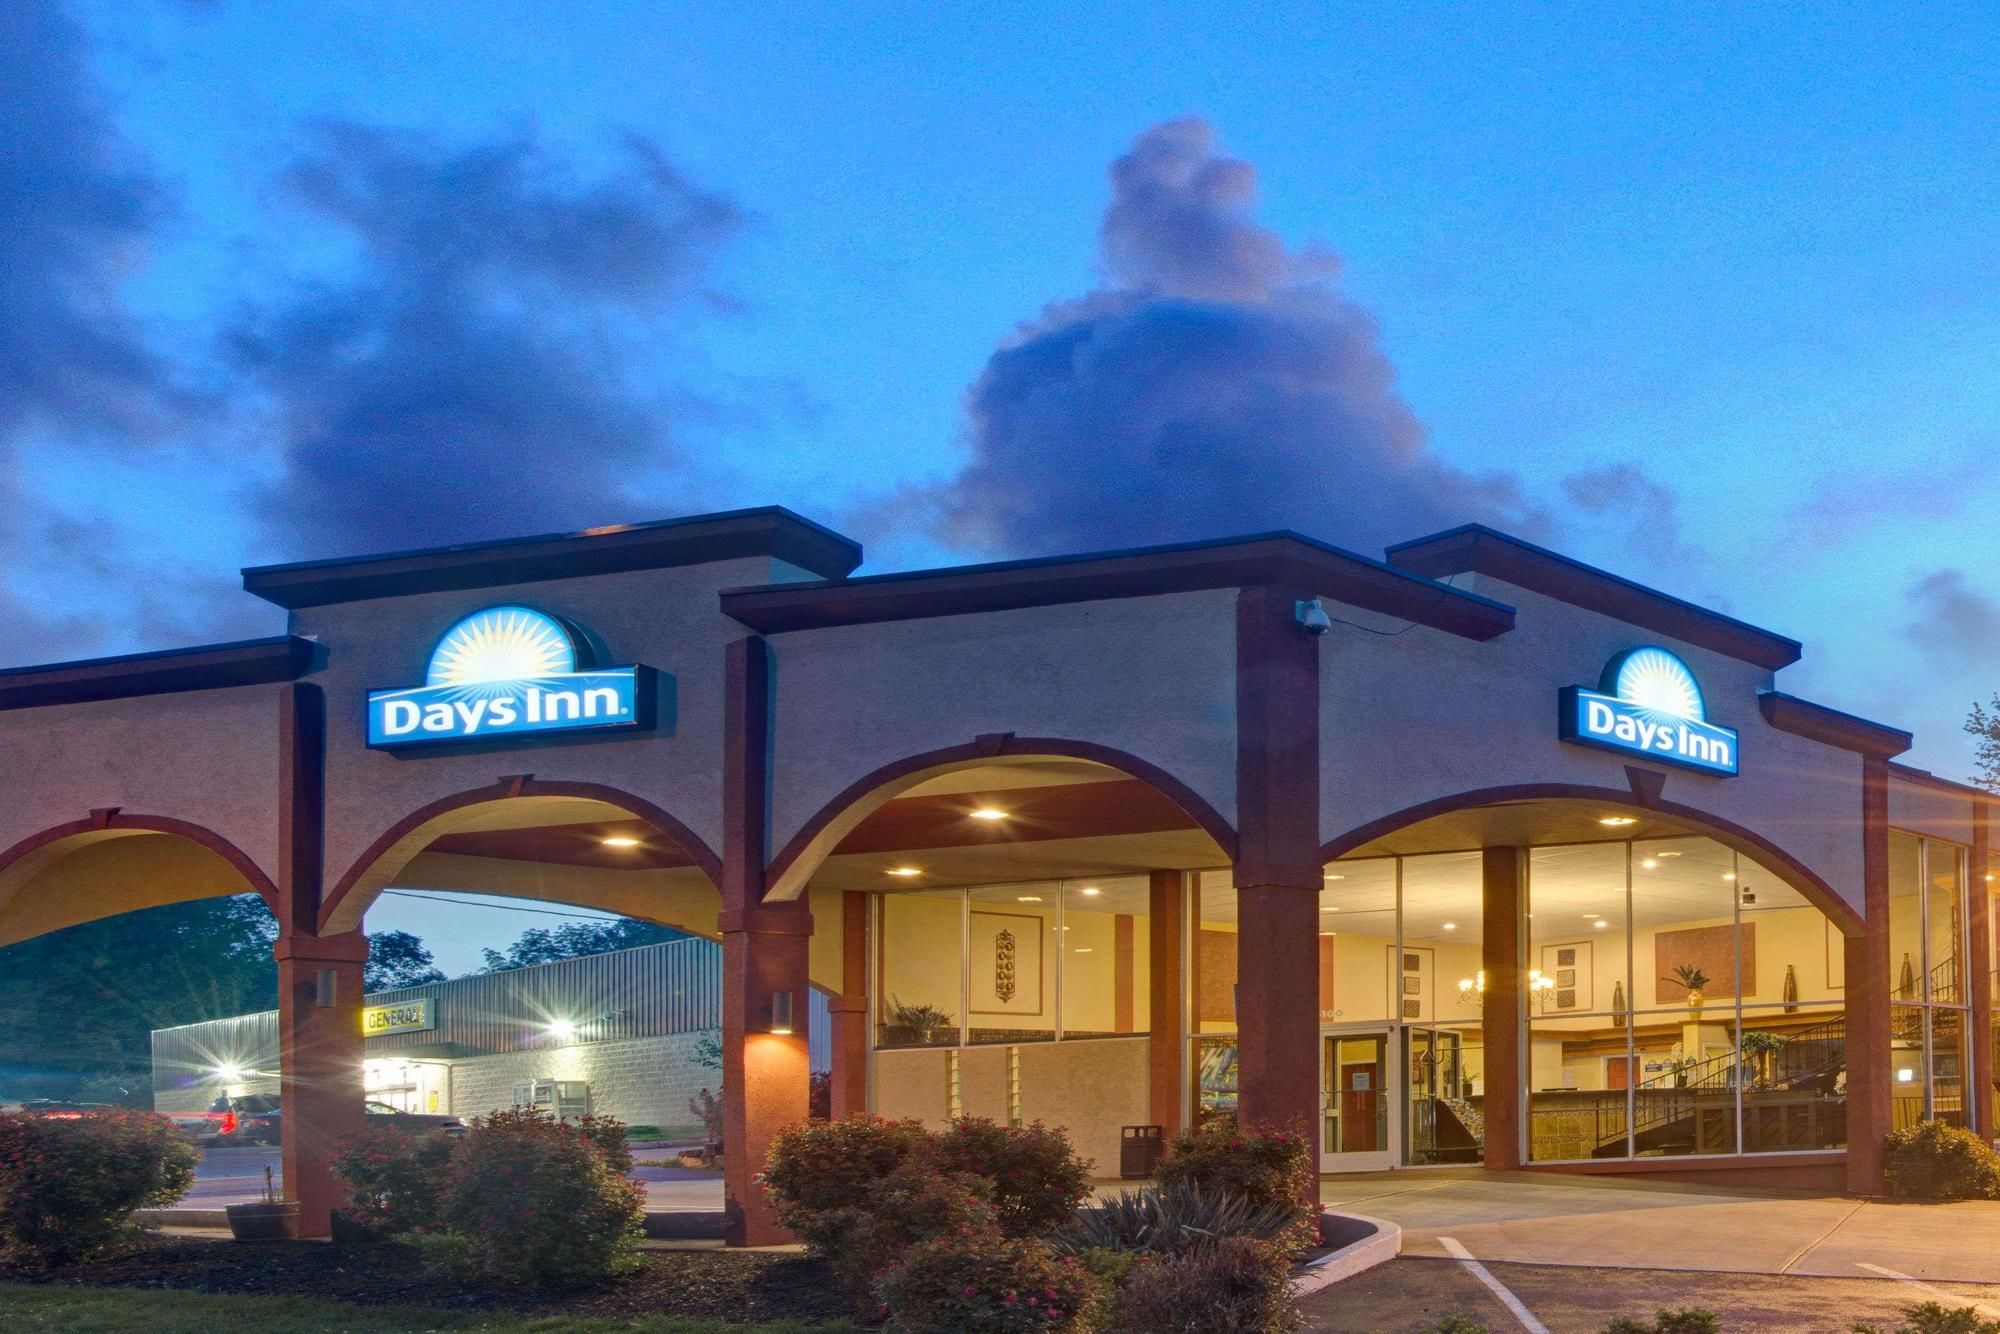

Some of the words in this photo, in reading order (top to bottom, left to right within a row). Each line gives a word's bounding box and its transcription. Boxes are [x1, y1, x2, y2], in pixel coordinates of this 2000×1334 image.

[384, 696, 515, 735] Days
[1588, 700, 1674, 750] Days
[368, 1007, 419, 1028] GENERAL
